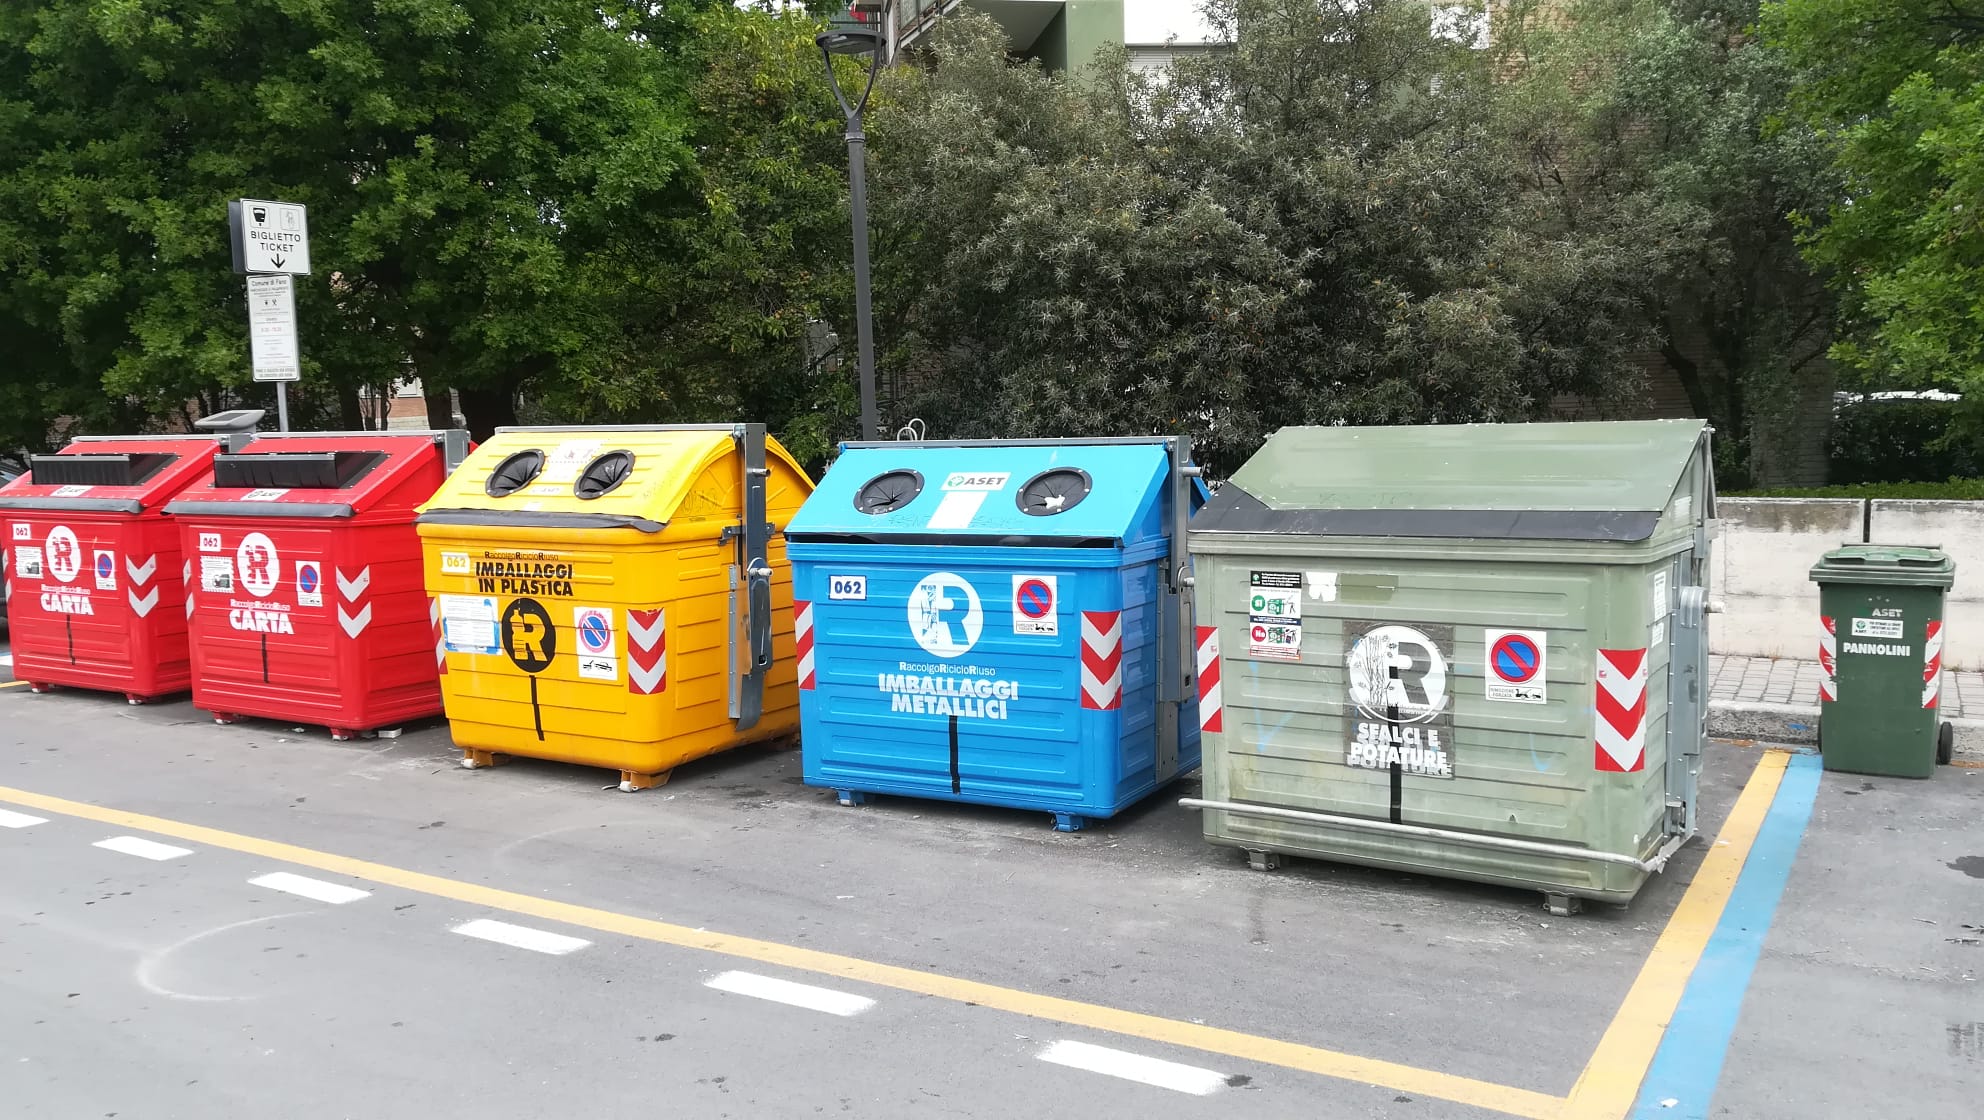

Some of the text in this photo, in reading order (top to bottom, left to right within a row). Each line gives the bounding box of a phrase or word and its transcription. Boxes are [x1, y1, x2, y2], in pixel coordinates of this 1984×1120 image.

[250, 230, 301, 242] BIGLIETTO
[260, 242, 294, 252] TICKET
[963, 476, 1005, 486] ASET
[15, 527, 28, 537] 062
[203, 537, 218, 547] 062
[446, 557, 466, 568] 062
[475, 562, 573, 580] IMBALLAGGI
[478, 580, 573, 597] IN PLASTICA
[834, 580, 862, 595] 062
[40, 593, 94, 615] CARTA
[1872, 608, 1903, 617] ASET
[229, 609, 295, 635] CARTA
[1843, 642, 1911, 656] PANNOLINI
[899, 661, 996, 676] RaccolgoRicicloRiuso
[878, 673, 1019, 701] IMBALLAGGI
[891, 694, 1008, 720] METALLICI
[1427, 729, 1439, 747] E
[1350, 741, 1447, 770] POTATURE
